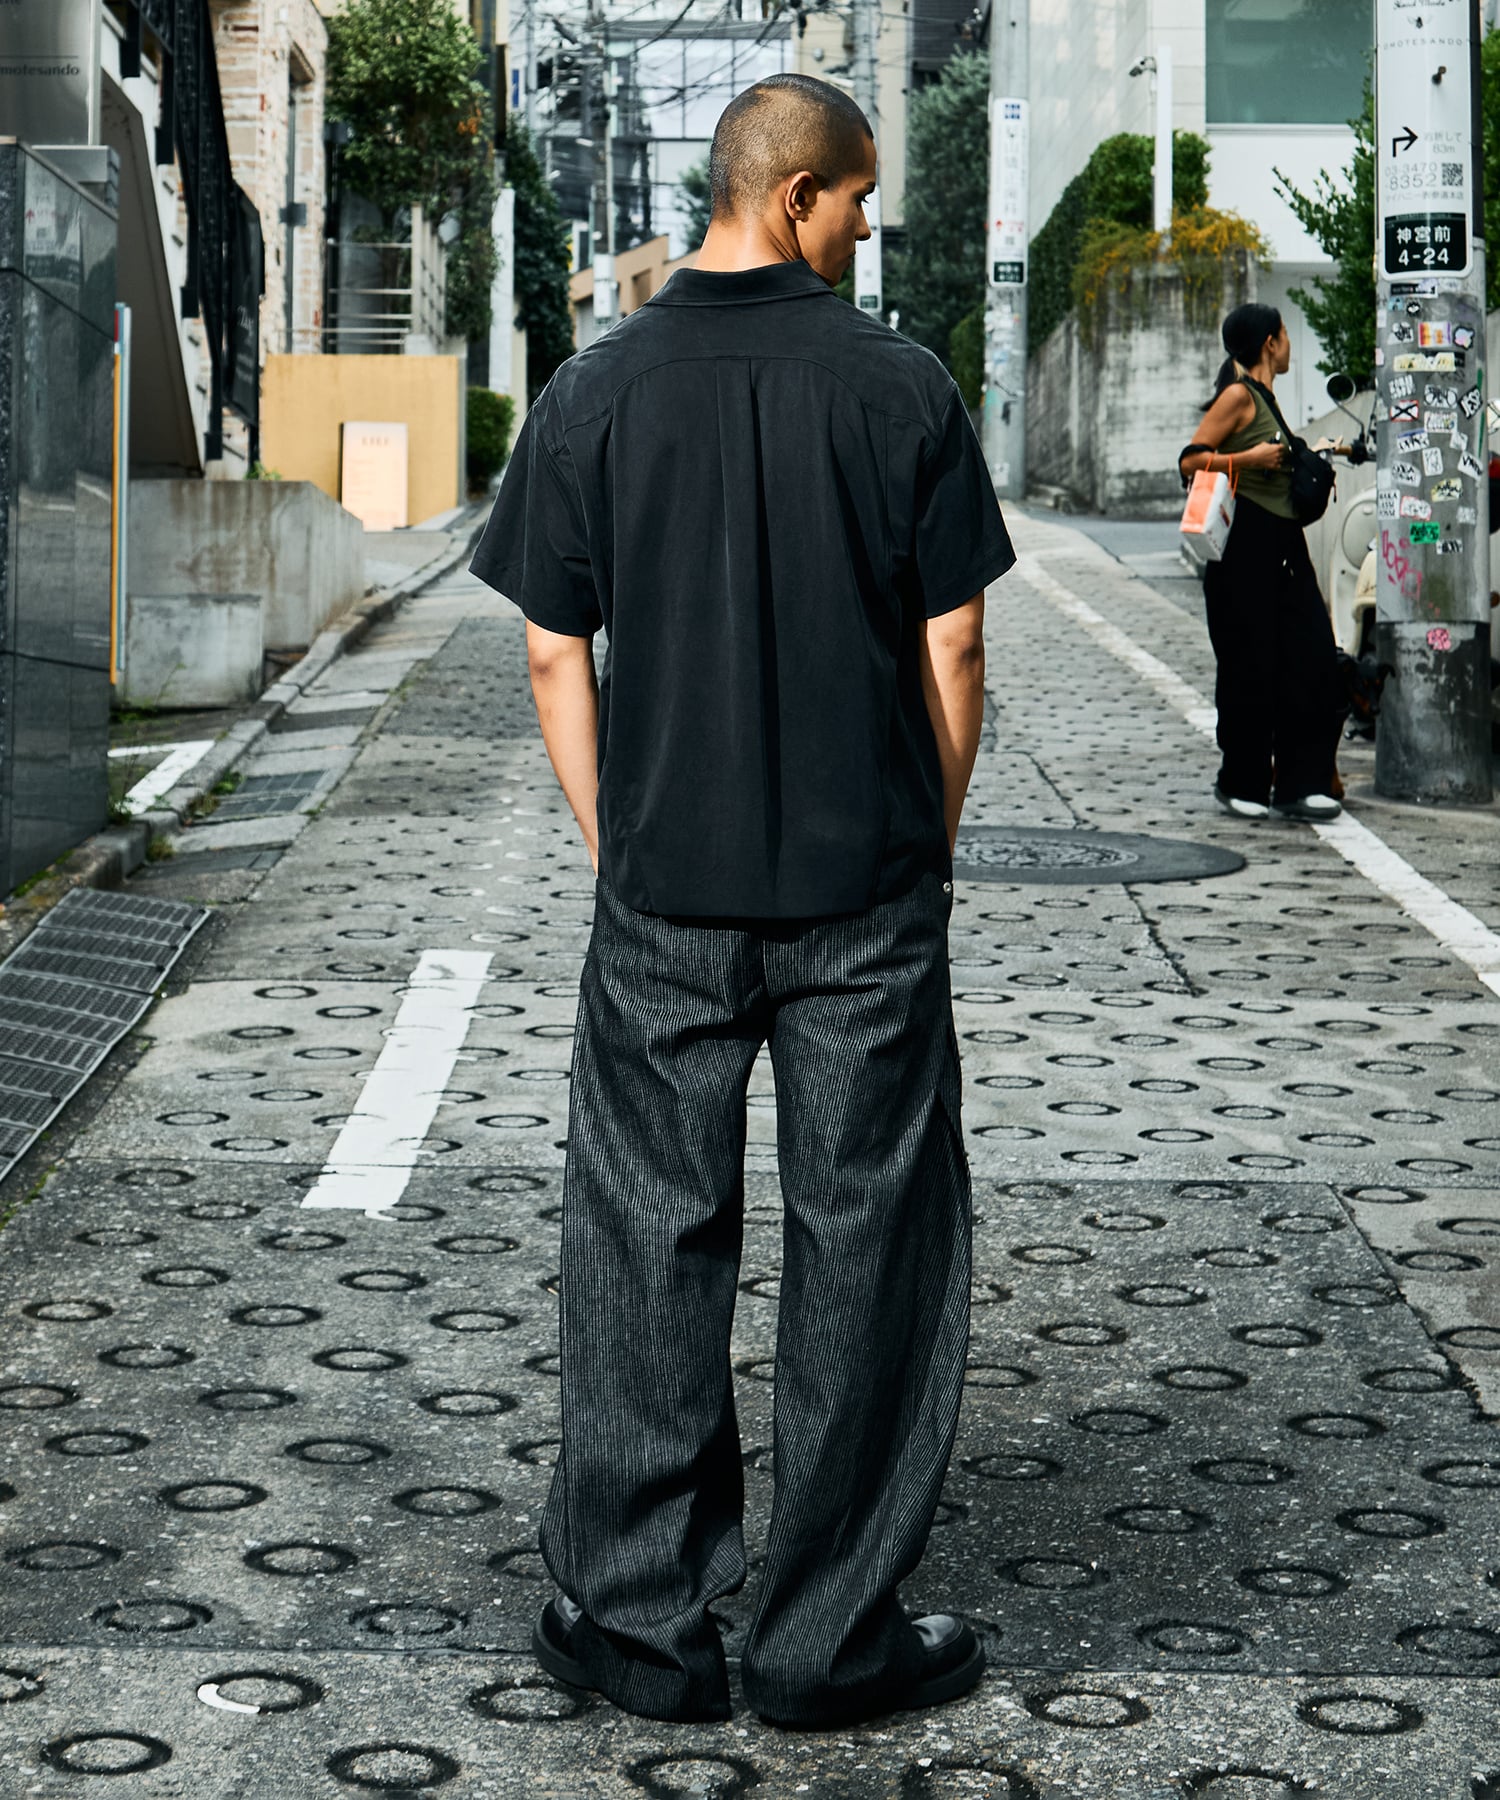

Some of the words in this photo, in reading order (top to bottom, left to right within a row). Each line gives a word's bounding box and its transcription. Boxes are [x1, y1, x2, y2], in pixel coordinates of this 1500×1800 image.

[1396, 225, 1452, 246] 神宮前
[1398, 247, 1450, 267] 4-24
